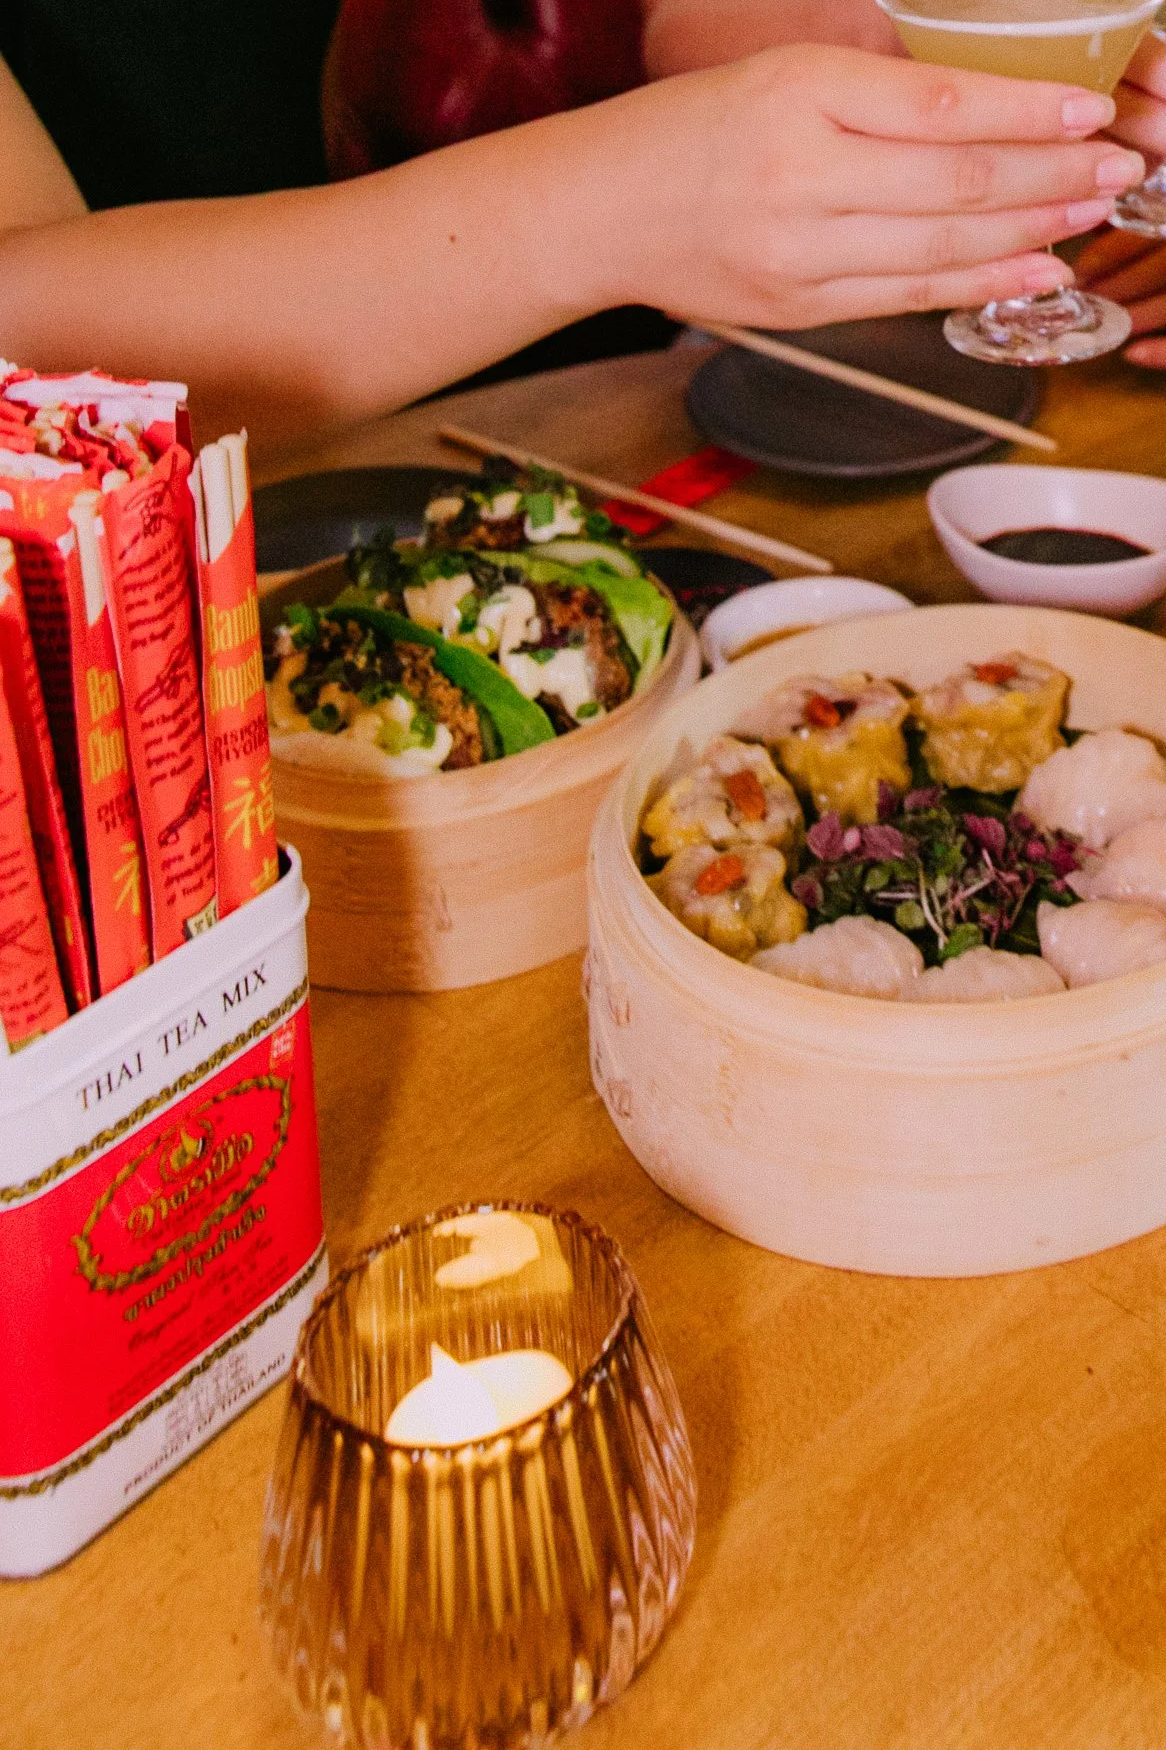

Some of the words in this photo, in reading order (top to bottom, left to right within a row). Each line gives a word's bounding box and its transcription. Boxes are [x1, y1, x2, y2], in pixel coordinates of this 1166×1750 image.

[76, 1051, 144, 1112] THAI
[157, 1008, 208, 1057] TEA
[219, 961, 267, 1014] MIX
